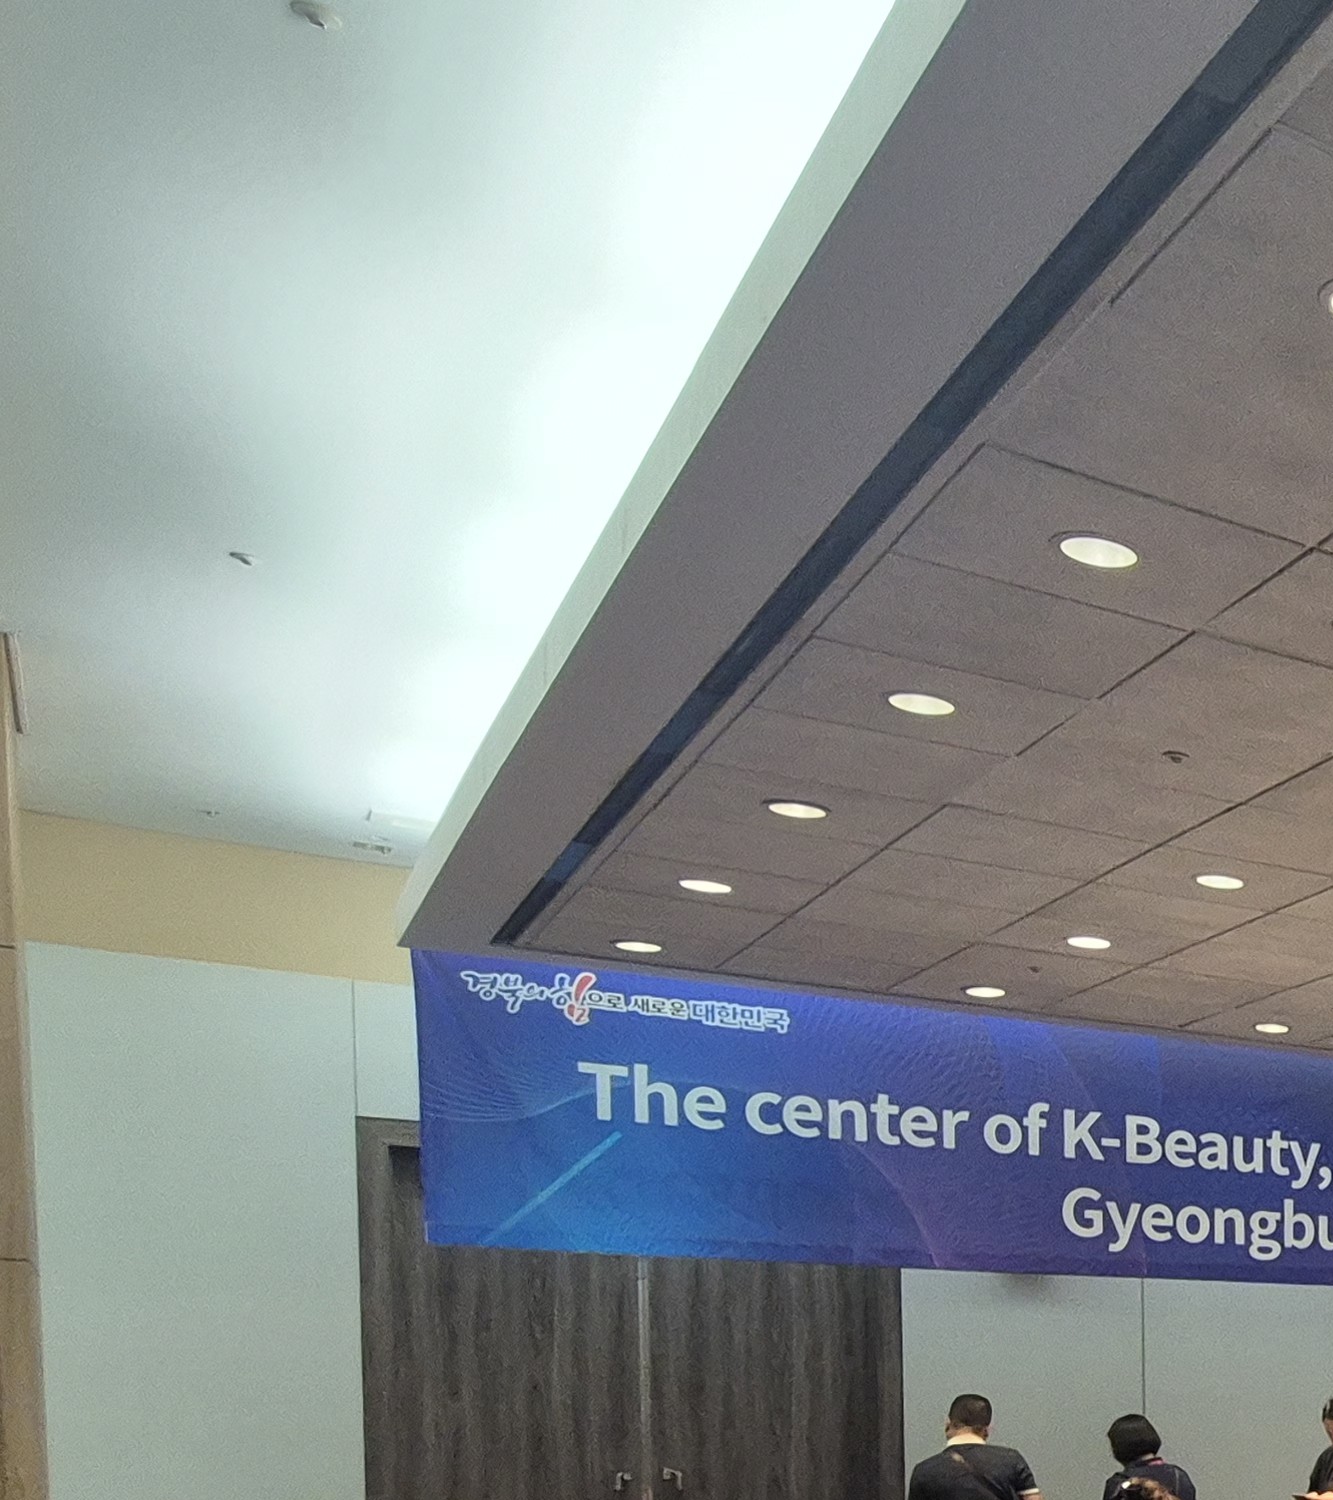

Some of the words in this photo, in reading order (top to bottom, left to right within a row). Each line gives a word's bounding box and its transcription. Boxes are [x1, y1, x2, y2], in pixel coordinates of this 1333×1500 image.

[629, 994, 688, 1020] 새로운
[689, 999, 791, 1034] 대한민국
[577, 1060, 727, 1131] The
[744, 1090, 970, 1149] center
[983, 1101, 1049, 1156] of
[1062, 1108, 1333, 1191] K-Beauty,
